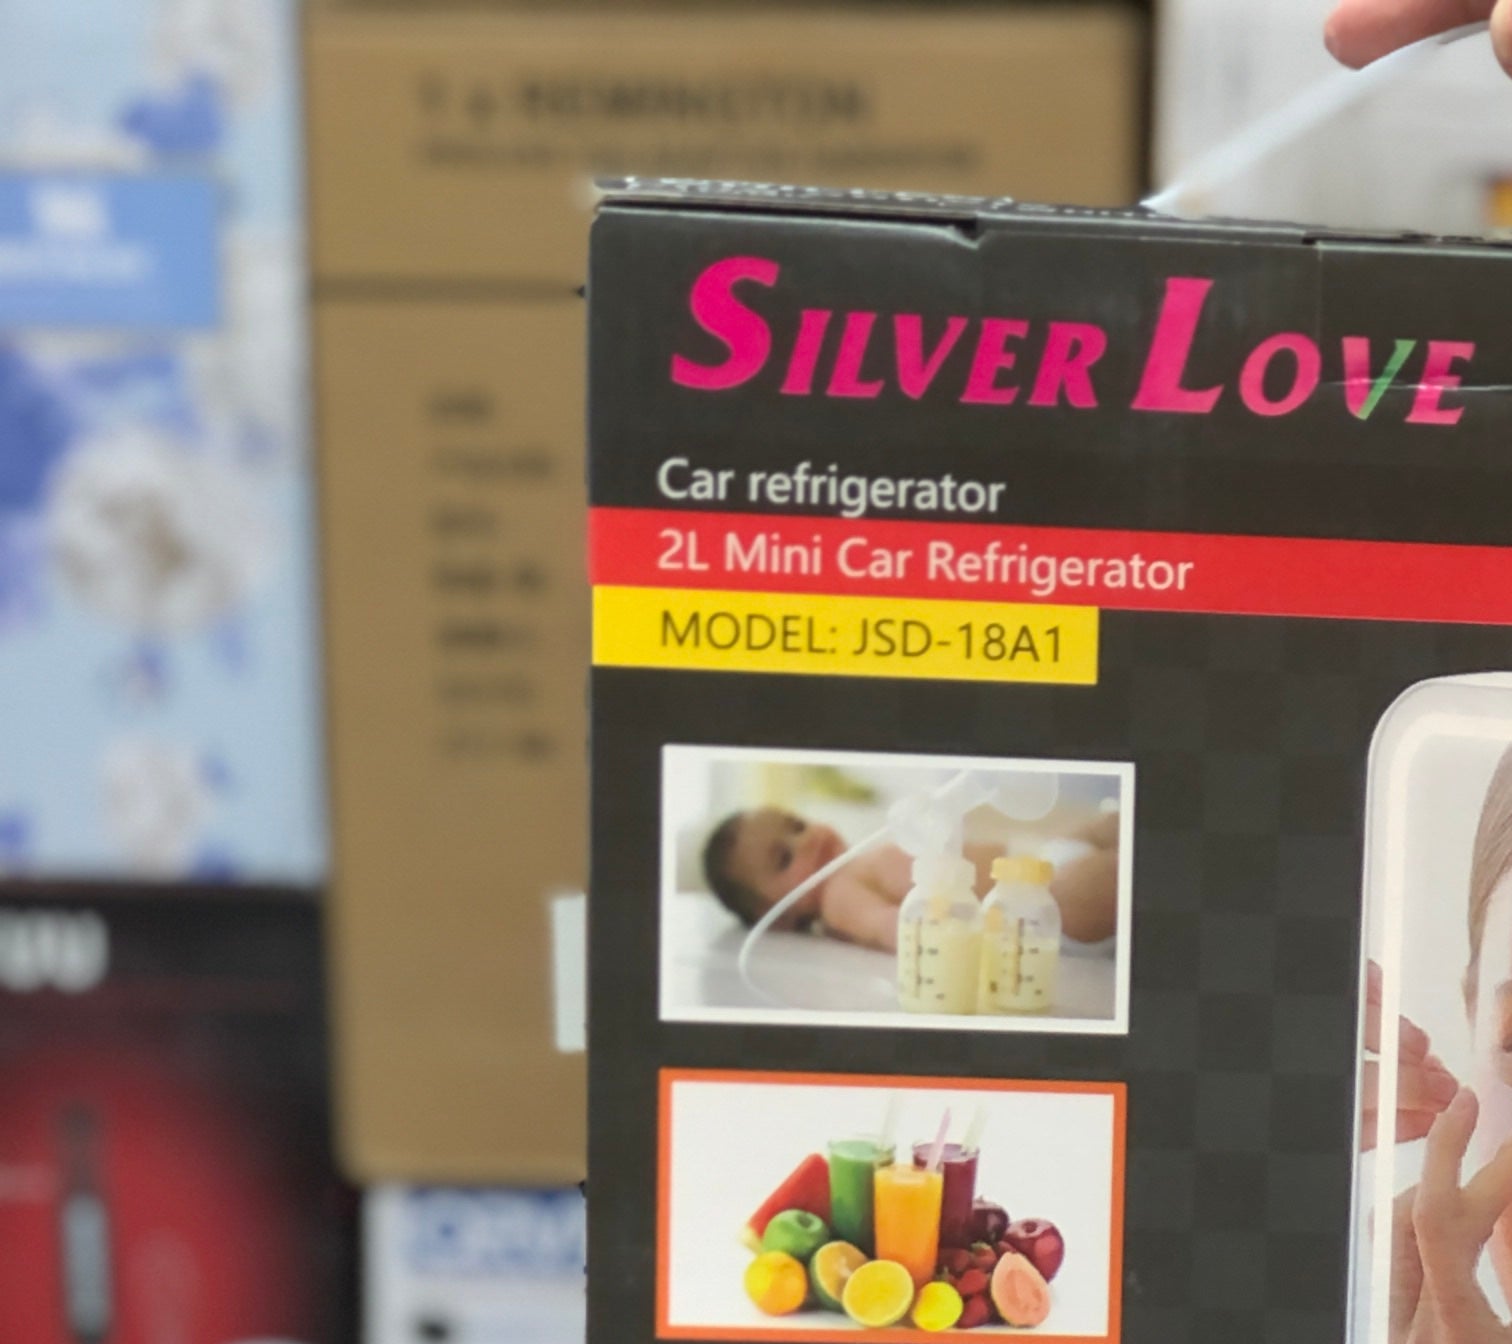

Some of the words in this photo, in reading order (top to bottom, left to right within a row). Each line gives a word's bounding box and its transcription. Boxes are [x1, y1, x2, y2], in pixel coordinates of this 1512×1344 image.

[668, 253, 1110, 411] SILVER
[1129, 274, 1478, 427] LOVE
[656, 456, 735, 501] Car
[748, 460, 1006, 519] refrigerator
[656, 527, 710, 572] 2L
[724, 531, 823, 576] Mini
[835, 536, 913, 580] Car
[926, 539, 1194, 598] Refrigerator
[660, 609, 838, 653] MODEL:
[852, 618, 1063, 664] JSD-18A1
